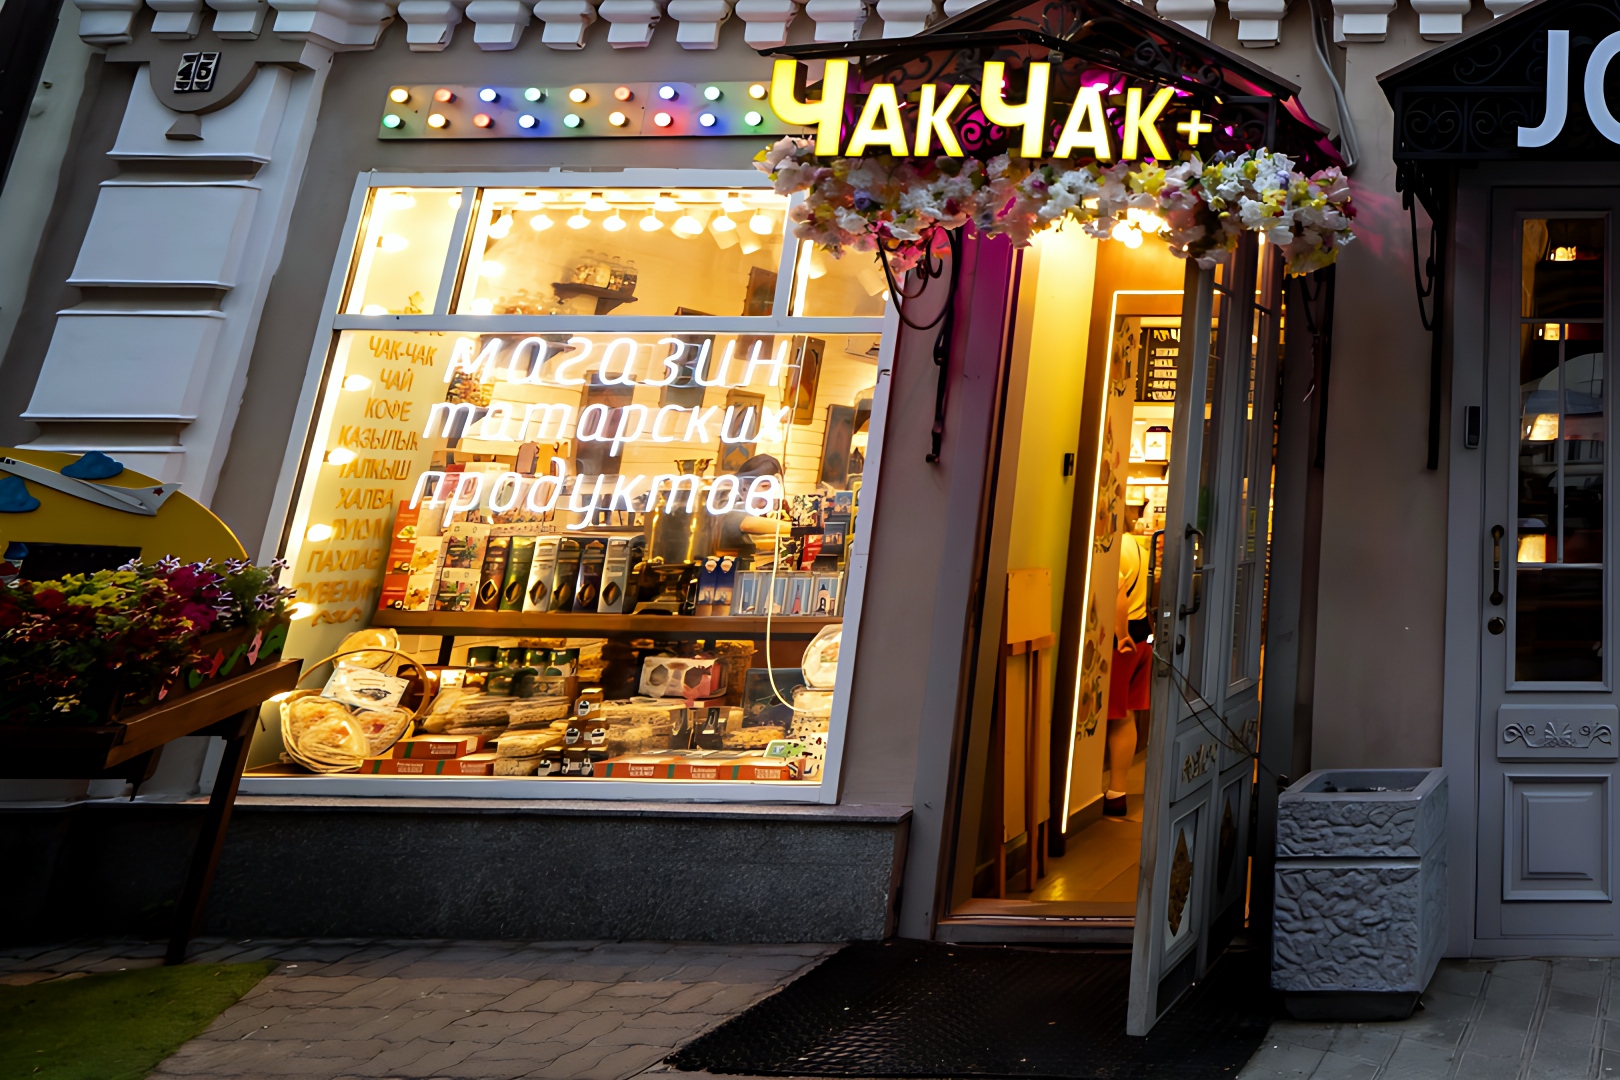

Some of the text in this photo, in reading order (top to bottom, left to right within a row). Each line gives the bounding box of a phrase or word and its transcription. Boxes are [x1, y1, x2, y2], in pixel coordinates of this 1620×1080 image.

[368, 335, 438, 366] ЧАК-ЧАК
[443, 336, 791, 388] магазин
[380, 368, 414, 392] ЧАЙ
[364, 397, 413, 422] КОФЕ
[422, 400, 791, 457] татарских
[335, 487, 395, 510] ХАЛВА
[408, 456, 786, 530] продуктов
